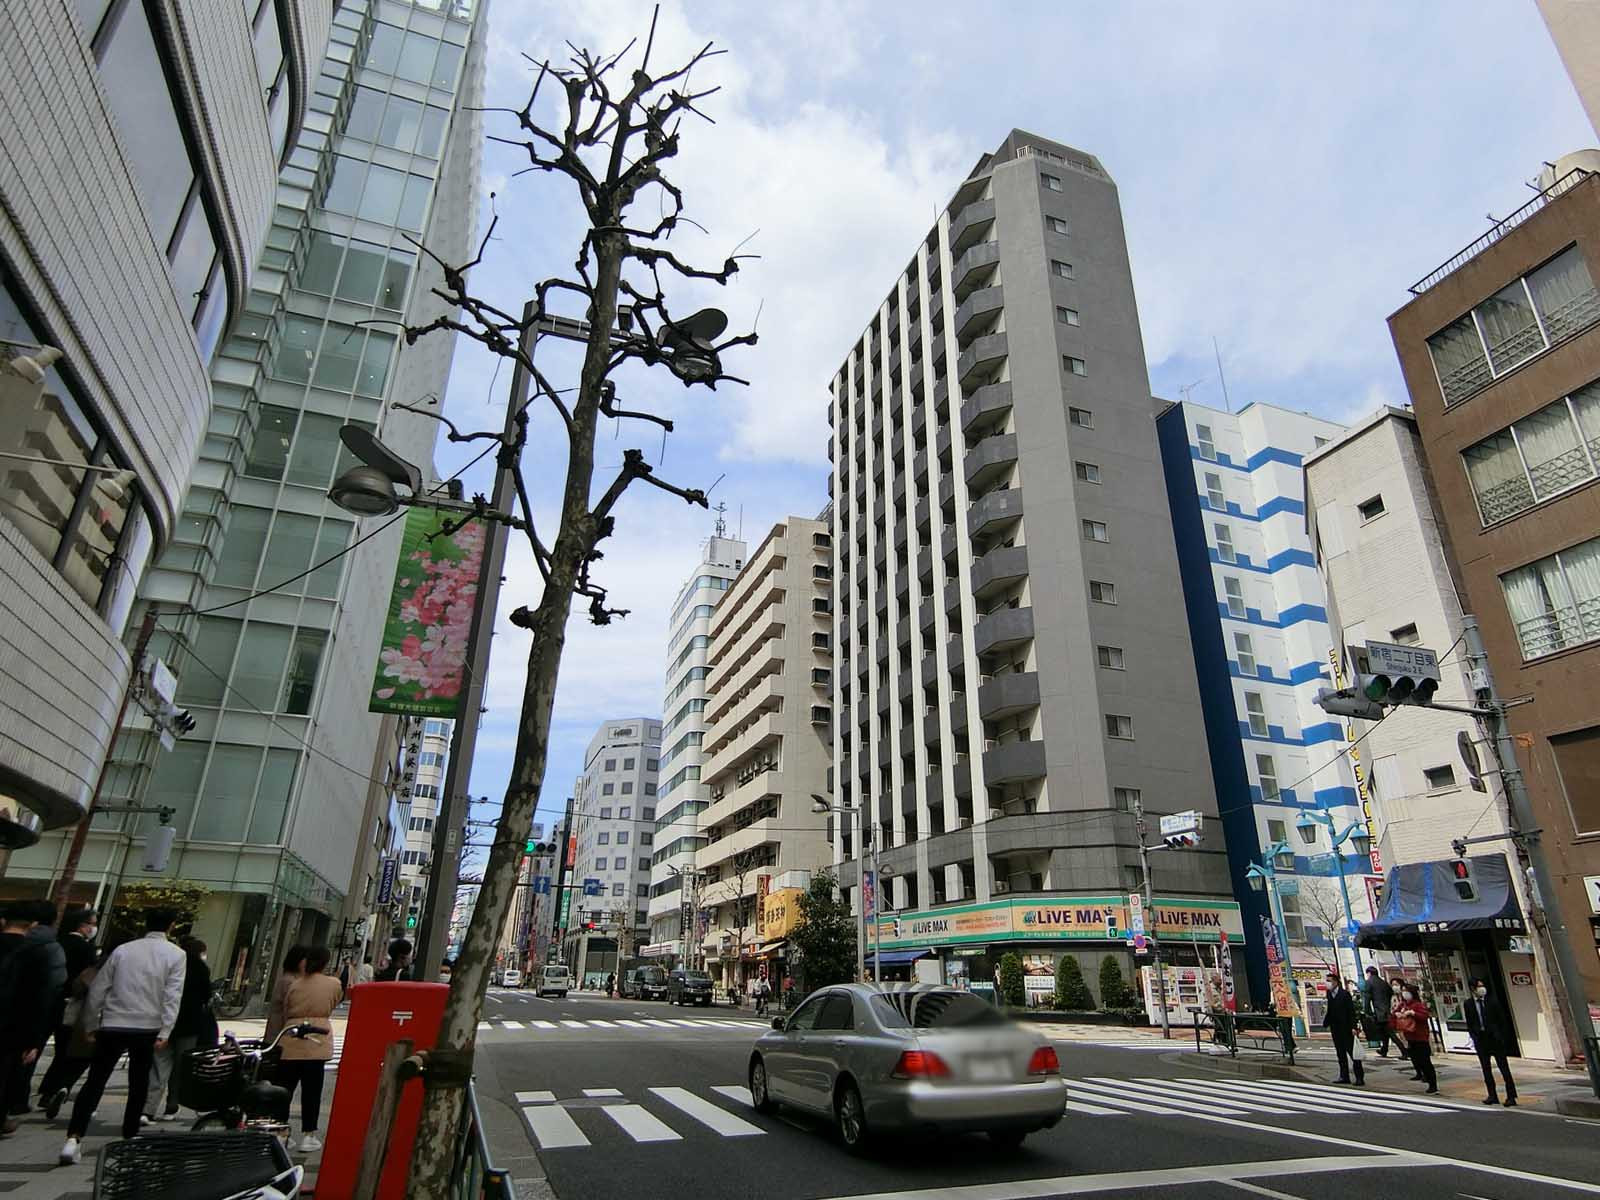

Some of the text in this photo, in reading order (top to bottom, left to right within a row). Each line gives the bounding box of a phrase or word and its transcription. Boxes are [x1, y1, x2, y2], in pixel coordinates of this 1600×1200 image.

[1370, 645, 1437, 668] 新宿二丁目東
[1076, 910, 1106, 924] MA
[1191, 912, 1222, 926] MAX
[933, 919, 948, 932] MAX
